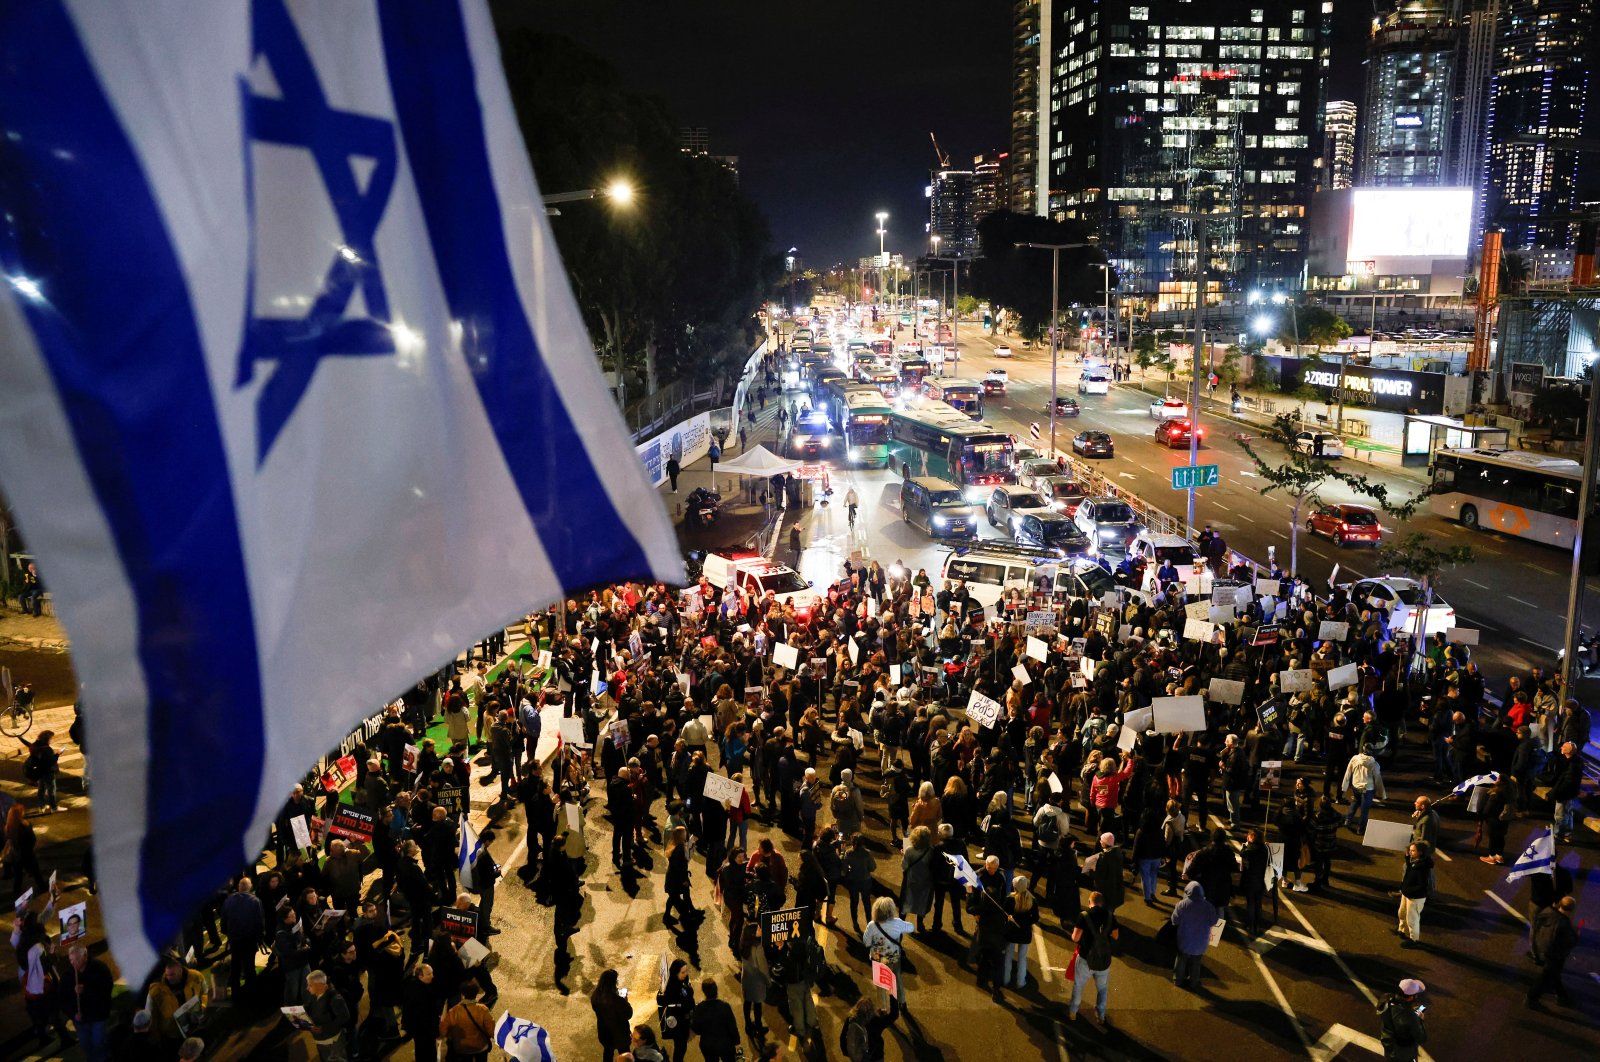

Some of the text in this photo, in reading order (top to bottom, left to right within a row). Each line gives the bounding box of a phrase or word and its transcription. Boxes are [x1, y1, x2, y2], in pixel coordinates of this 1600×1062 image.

[1340, 375, 1371, 392] PIRAL
[1371, 378, 1412, 396] TOWER
[1360, 390, 1377, 404] SOON
[363, 713, 383, 741] Them
[771, 910, 802, 924] HOSTAGE
[771, 922, 789, 933] DEAL
[771, 931, 789, 942] NOW
